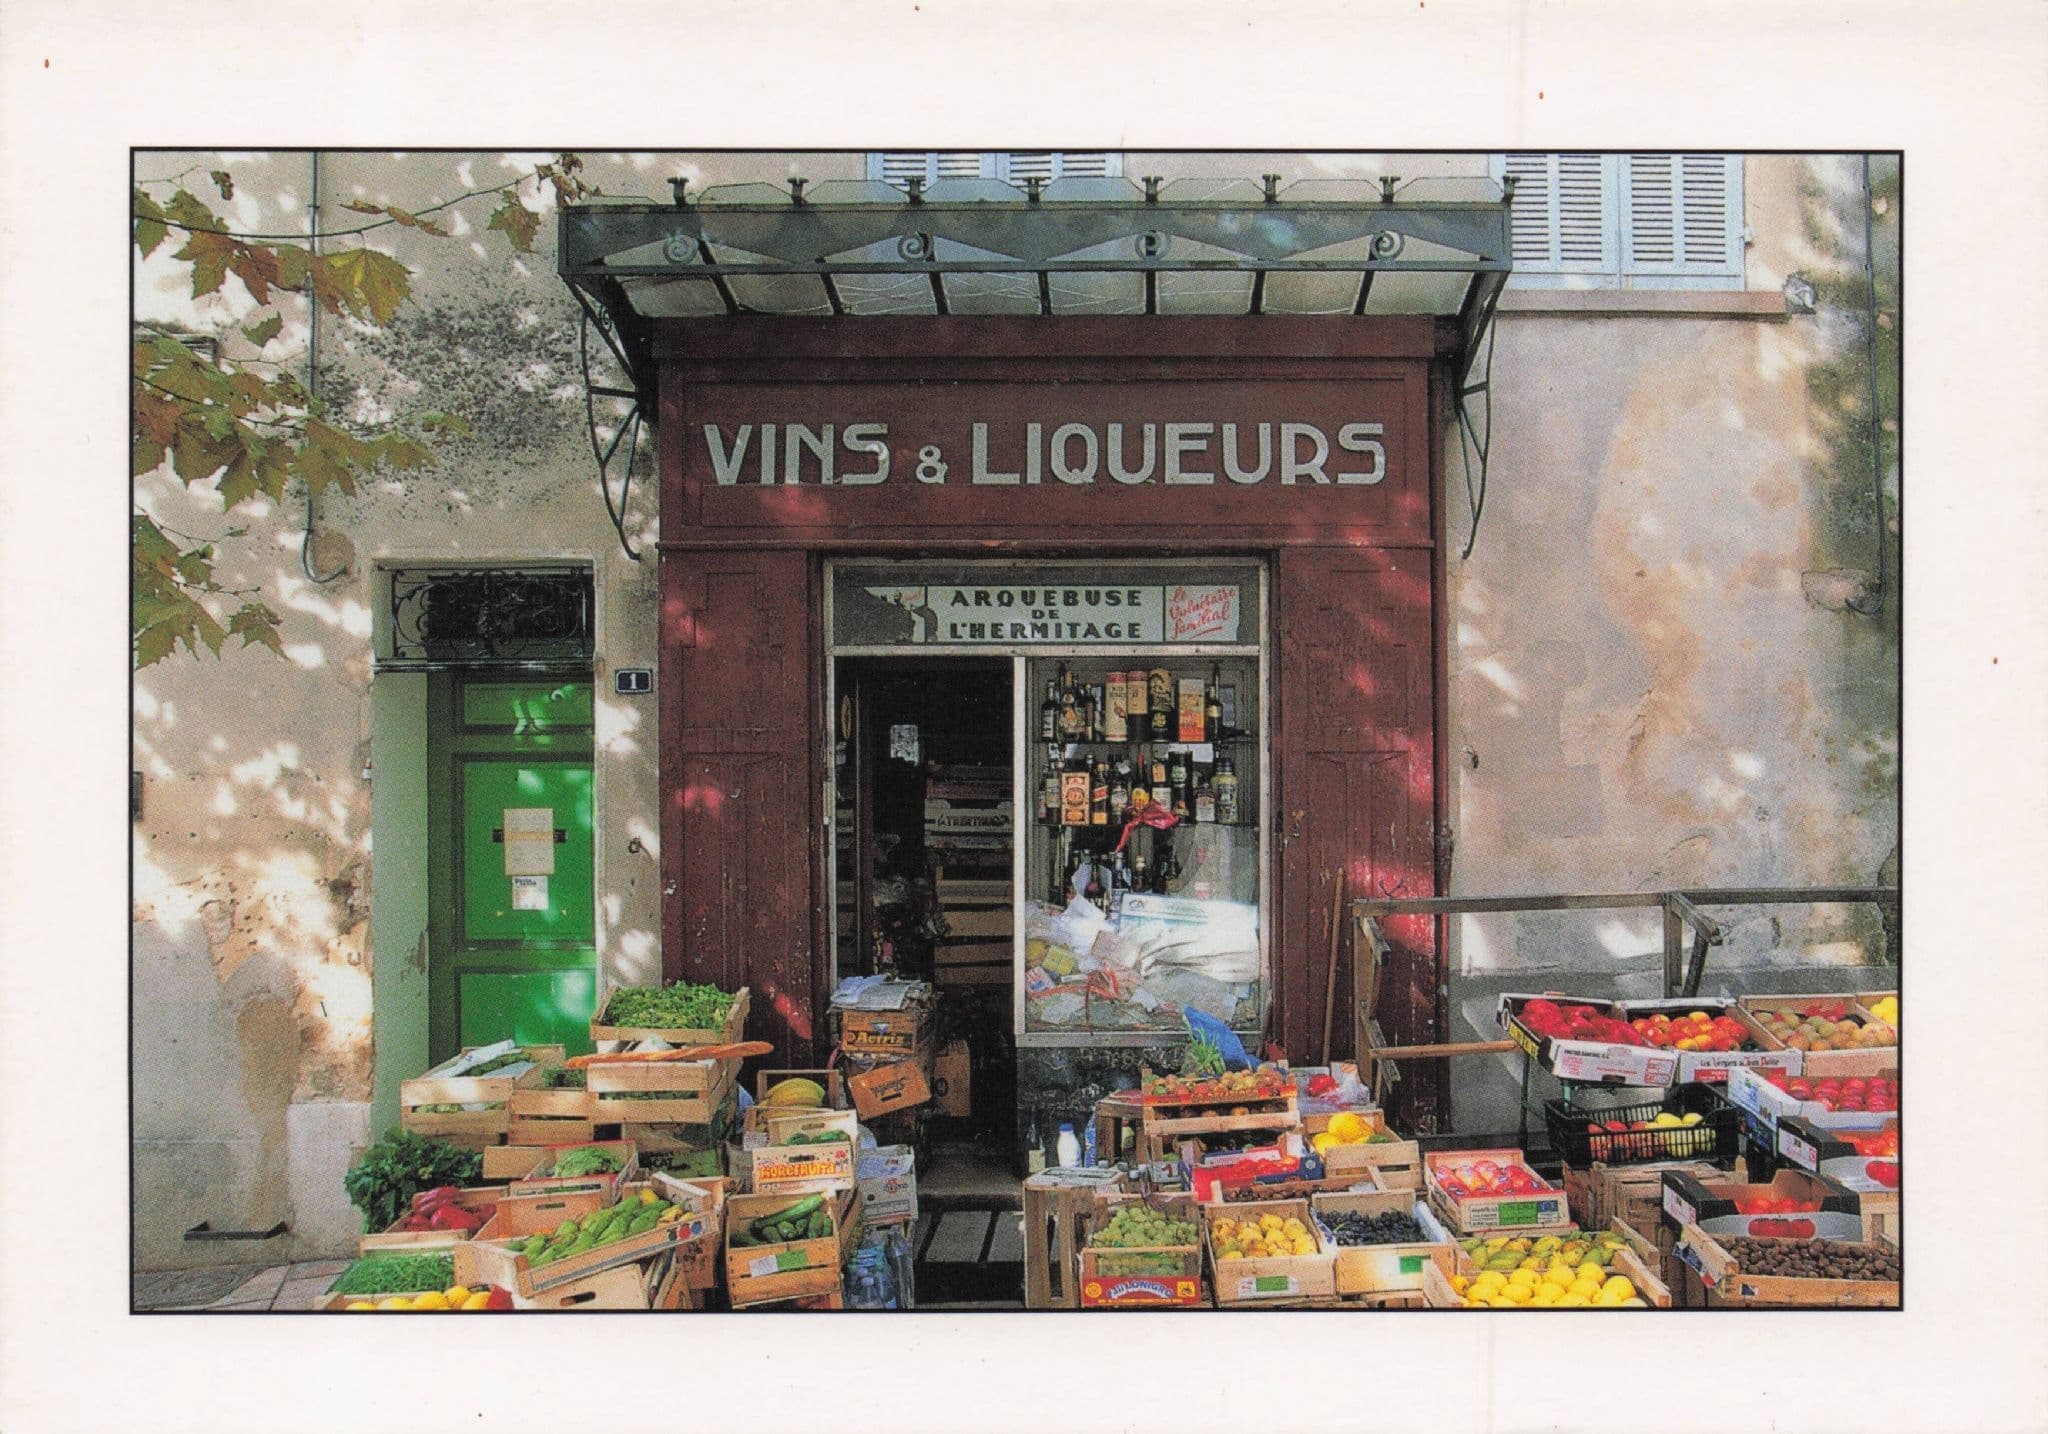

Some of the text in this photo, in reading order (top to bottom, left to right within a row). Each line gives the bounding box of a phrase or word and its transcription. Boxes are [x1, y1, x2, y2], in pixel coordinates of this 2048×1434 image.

[703, 422, 1387, 486] VINS & LIQUEURS
[949, 589, 1143, 607] ARQUEBUSE
[1031, 609, 1060, 620] DE
[949, 622, 1143, 640] L'HERMITAGE
[629, 672, 638, 690] 1
